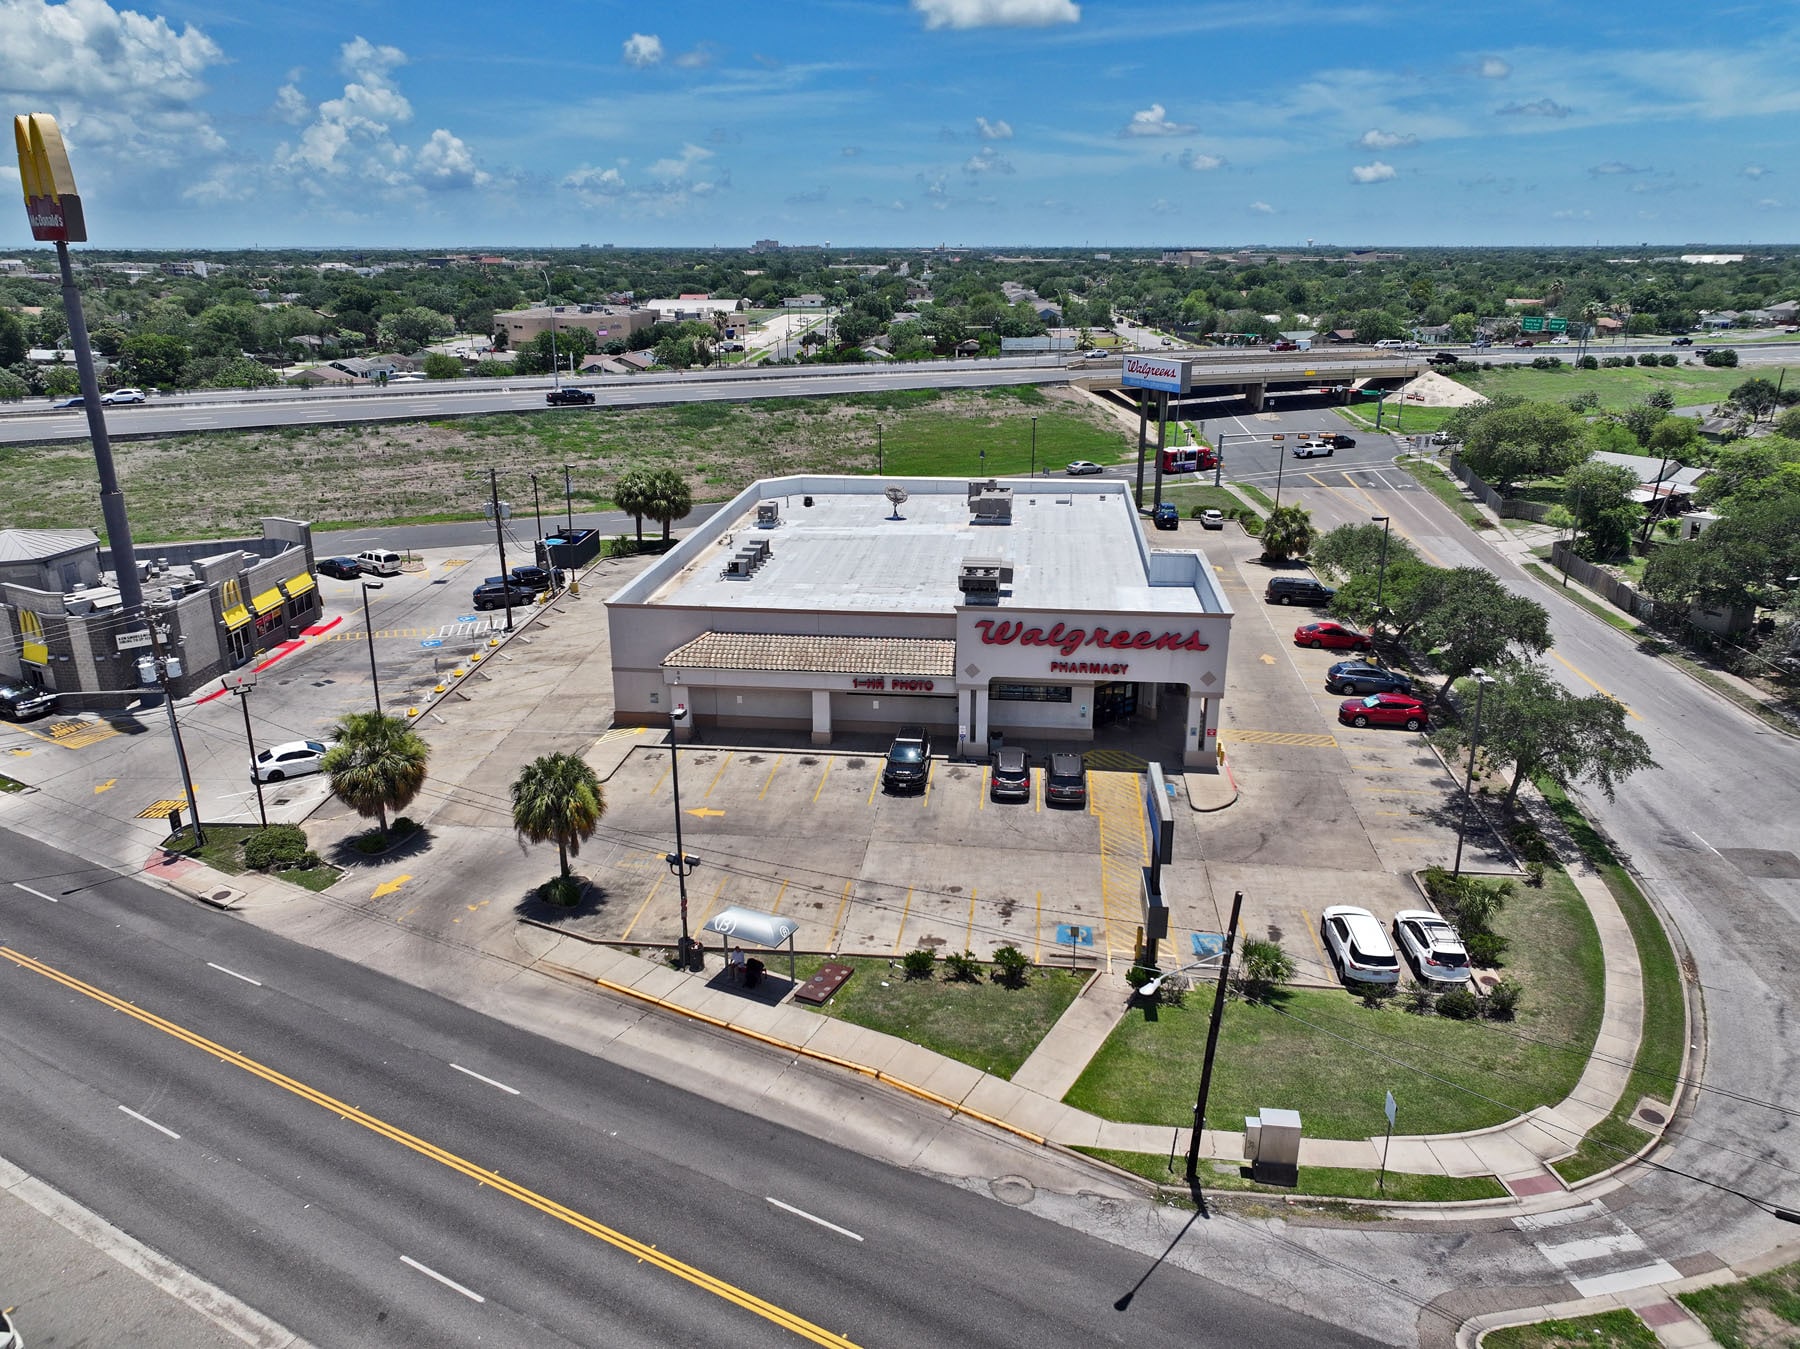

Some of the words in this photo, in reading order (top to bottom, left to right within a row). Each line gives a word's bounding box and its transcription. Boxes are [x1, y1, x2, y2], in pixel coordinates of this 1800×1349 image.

[1127, 359, 1177, 379] Walgreens
[974, 619, 1210, 657] Walgreens
[1050, 661, 1129, 675] PHARMACY
[852, 678, 885, 690] 1-HR
[891, 679, 934, 692] PHOTO
